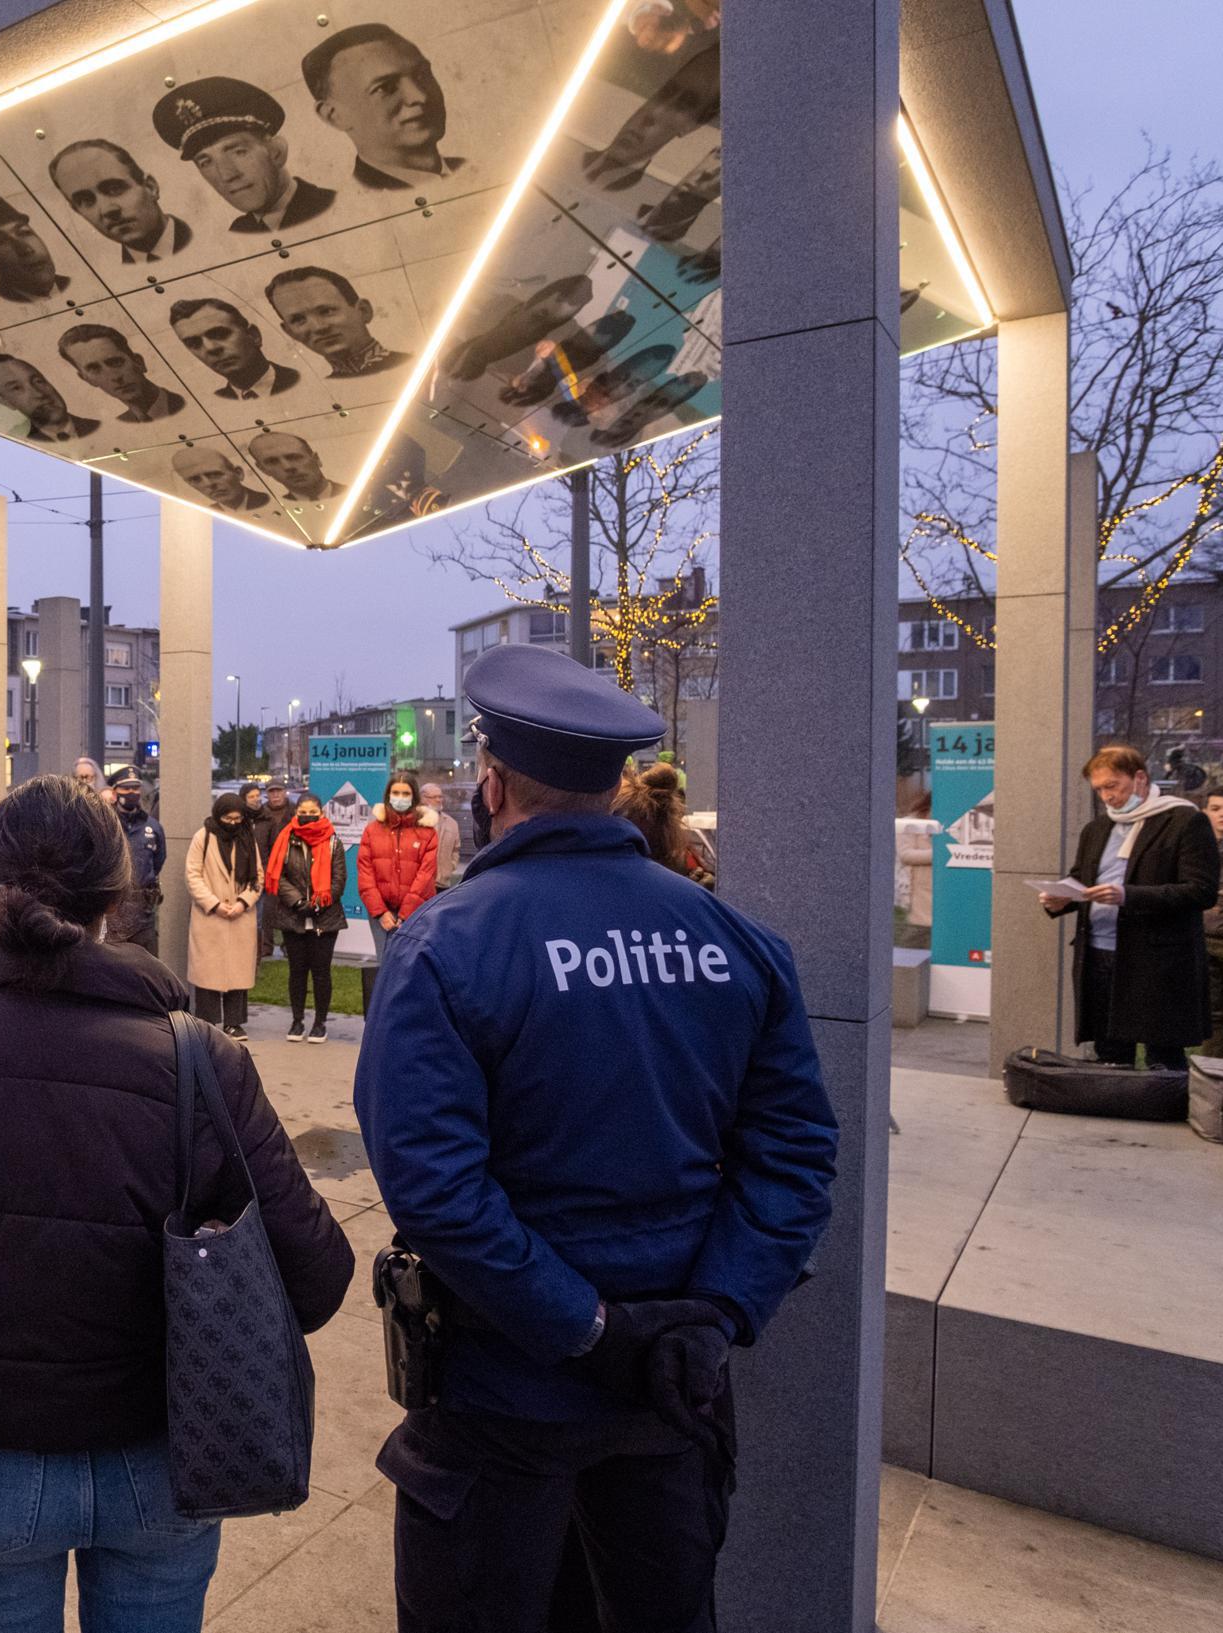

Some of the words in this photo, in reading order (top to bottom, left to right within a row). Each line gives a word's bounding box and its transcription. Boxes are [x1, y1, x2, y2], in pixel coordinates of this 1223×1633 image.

[312, 744, 330, 759] 14
[332, 742, 387, 761] januari
[936, 735, 968, 754] 14
[544, 929, 731, 992] Politie
